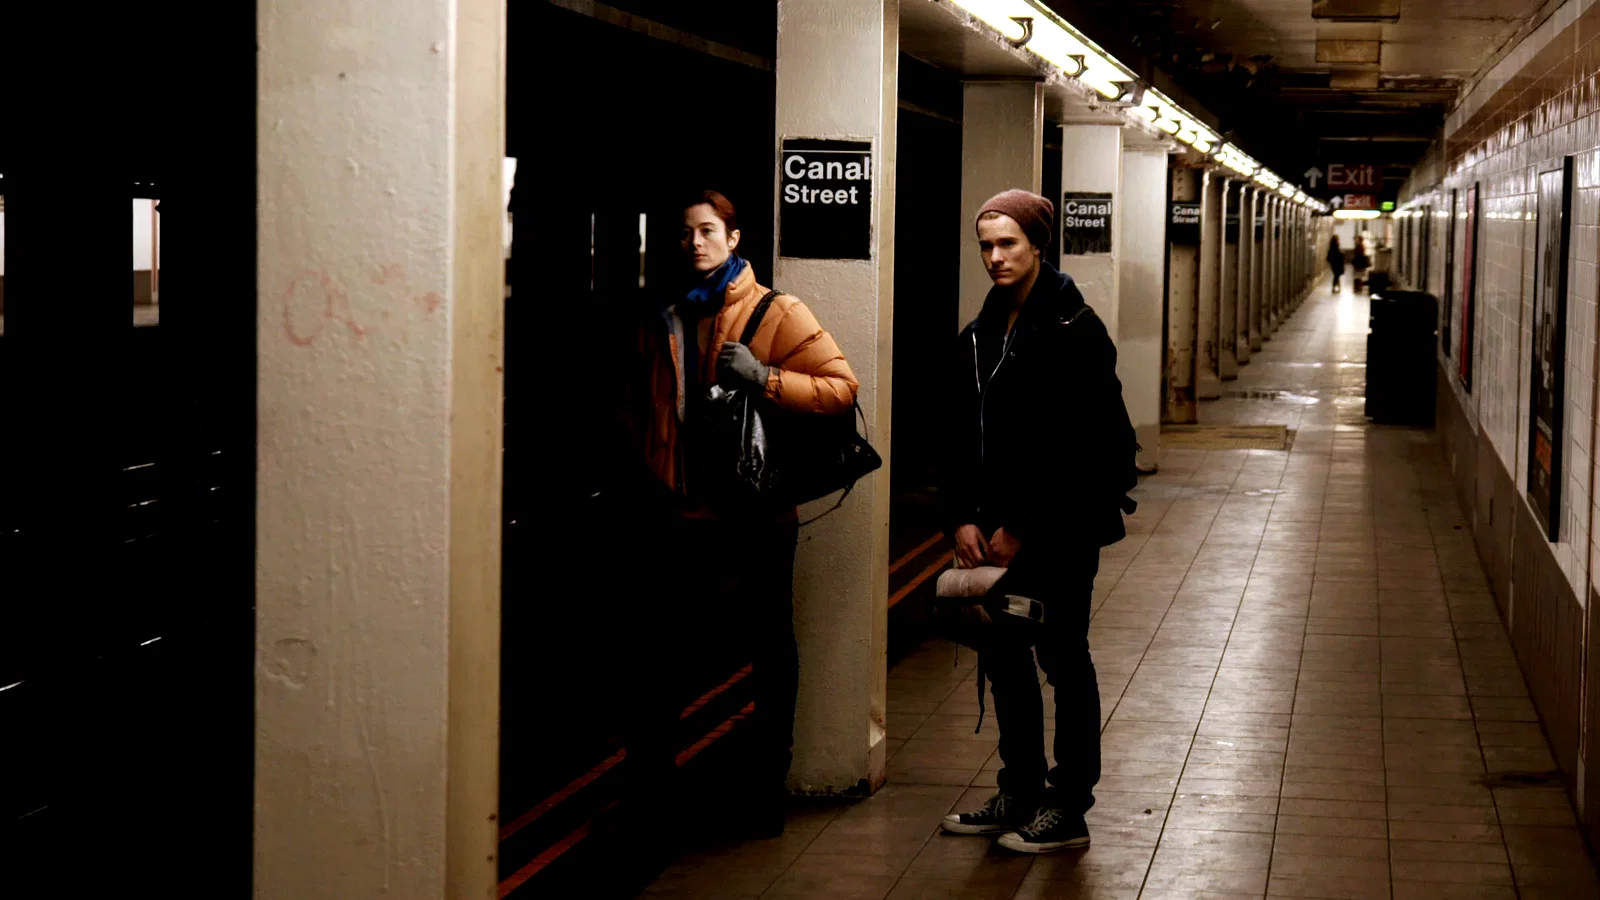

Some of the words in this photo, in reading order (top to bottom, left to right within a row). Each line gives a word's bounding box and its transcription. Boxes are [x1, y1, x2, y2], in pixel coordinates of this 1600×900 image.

[784, 154, 870, 180] Canal
[1327, 163, 1375, 186] Exit
[784, 183, 858, 204] Street
[1066, 201, 1112, 215] Canal
[1172, 205, 1201, 216] Cana
[1066, 216, 1105, 227] Street
